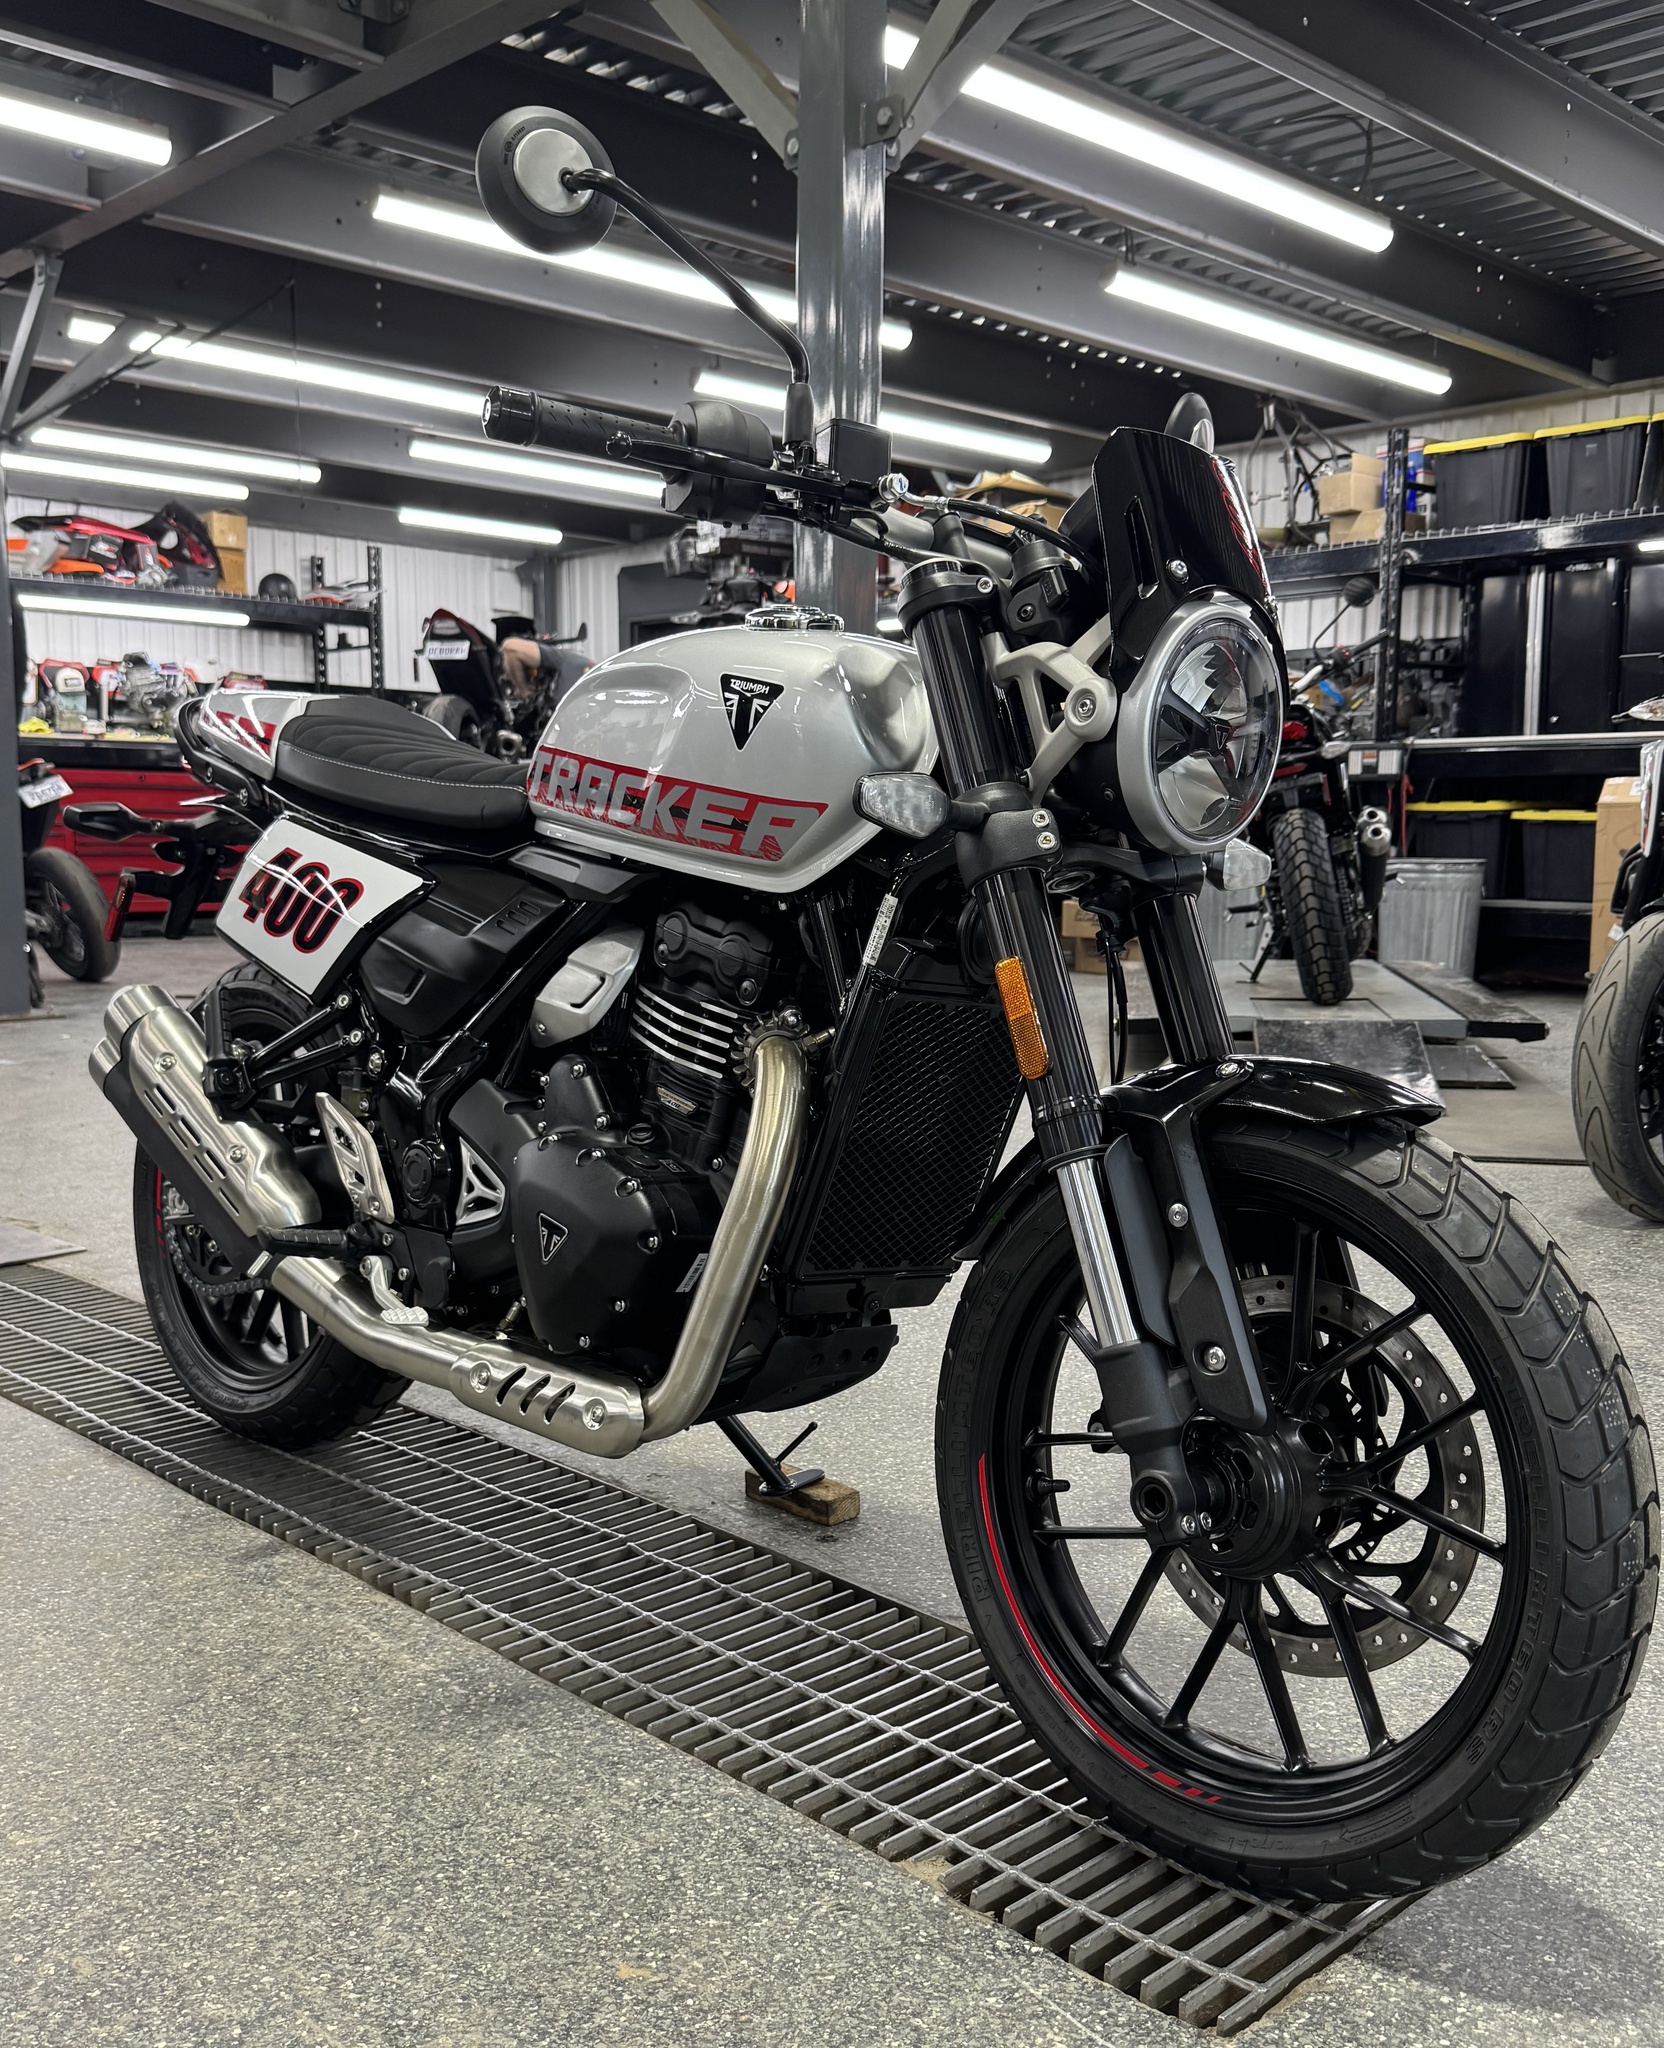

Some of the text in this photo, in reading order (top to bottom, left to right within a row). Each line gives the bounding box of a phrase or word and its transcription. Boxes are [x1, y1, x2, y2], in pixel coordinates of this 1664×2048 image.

[730, 678, 770, 696] TRIUMPH
[529, 749, 824, 857] TRACKER
[238, 846, 365, 955] 400
[951, 1324, 986, 1428] MT60
[950, 1440, 992, 1603] PIRELLI
